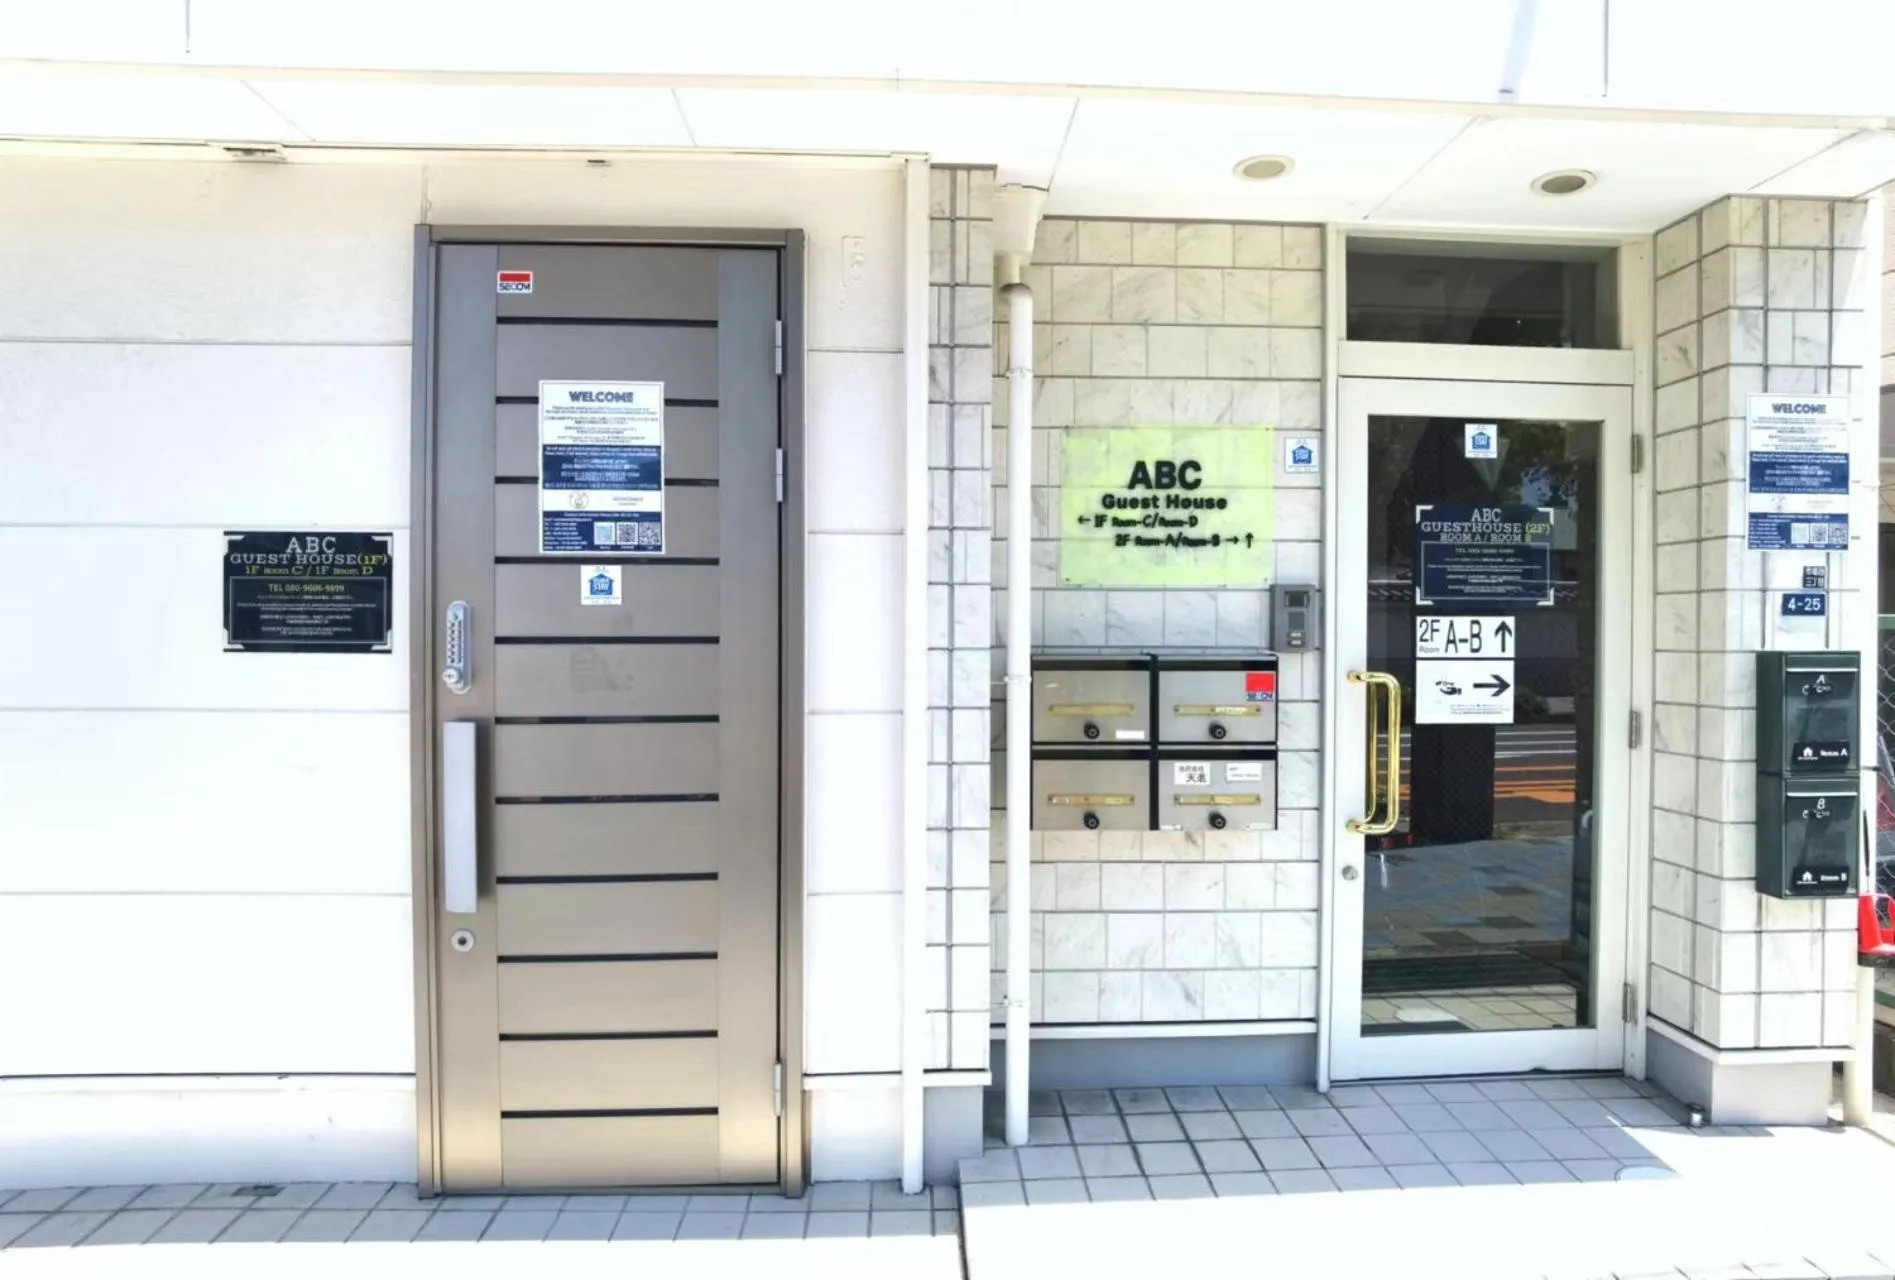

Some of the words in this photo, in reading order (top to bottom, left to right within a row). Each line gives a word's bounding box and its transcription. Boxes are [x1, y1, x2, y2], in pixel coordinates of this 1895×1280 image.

[569, 391, 634, 403] WELCOME
[1771, 403, 1827, 414] WELCOME
[1127, 460, 1202, 490] ABC
[1101, 494, 1160, 509] Guest
[1166, 494, 1228, 509] House
[1471, 508, 1503, 522] ABC
[286, 536, 337, 553] ABC
[1114, 533, 1130, 547] 2F
[1440, 533, 1471, 543] ROOM
[1490, 534, 1521, 543] ROOM
[230, 553, 290, 565] GUEST
[291, 565, 303, 576] C
[361, 566, 374, 575] D
[268, 584, 283, 592] TEL
[1788, 597, 1821, 611] 4-25
[1419, 619, 1440, 642] 2F
[1444, 619, 1482, 653] A-B
[1840, 748, 1848, 757] A
